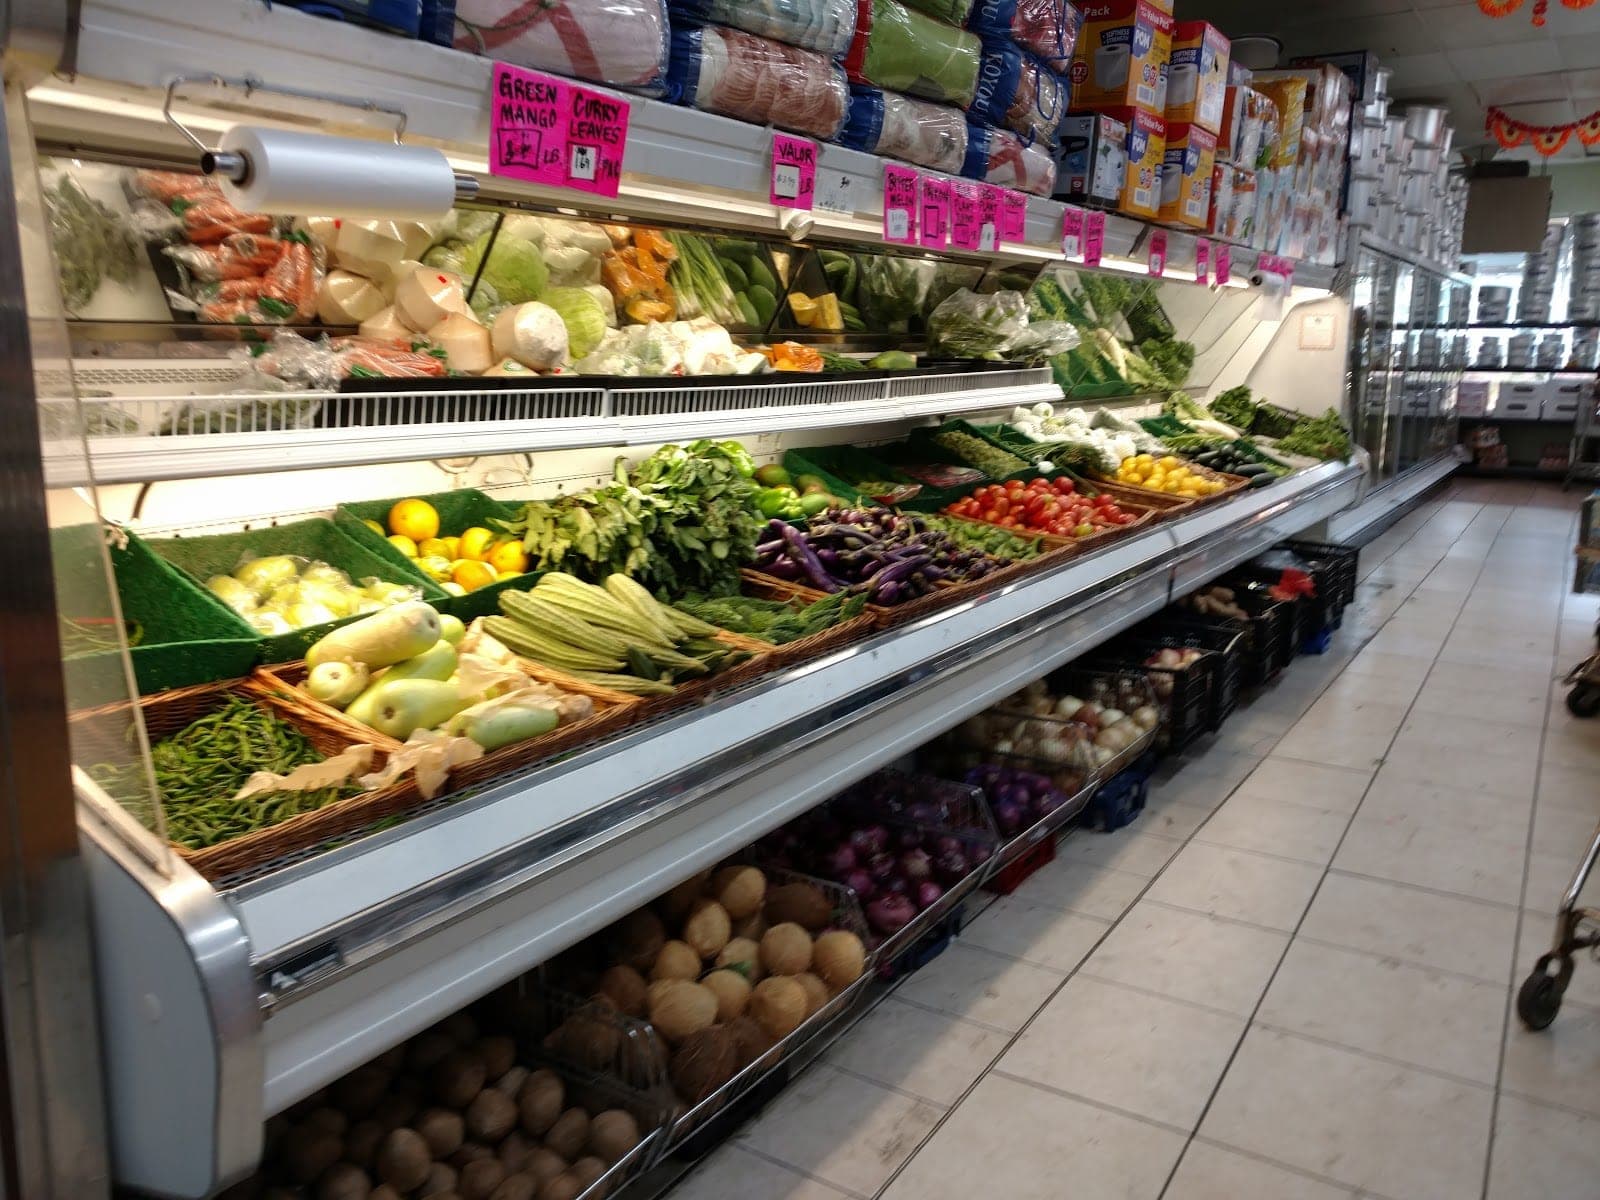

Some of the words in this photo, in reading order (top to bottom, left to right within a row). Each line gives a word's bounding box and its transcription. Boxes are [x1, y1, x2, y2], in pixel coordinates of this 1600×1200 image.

[1084, 6, 1110, 17] Pack
[1135, 29, 1150, 48] POM
[499, 72, 557, 104] GREEN
[500, 103, 557, 128] MANGO
[573, 92, 620, 121] CURRY
[569, 121, 622, 144] LEAVES
[778, 142, 815, 167] VALOR
